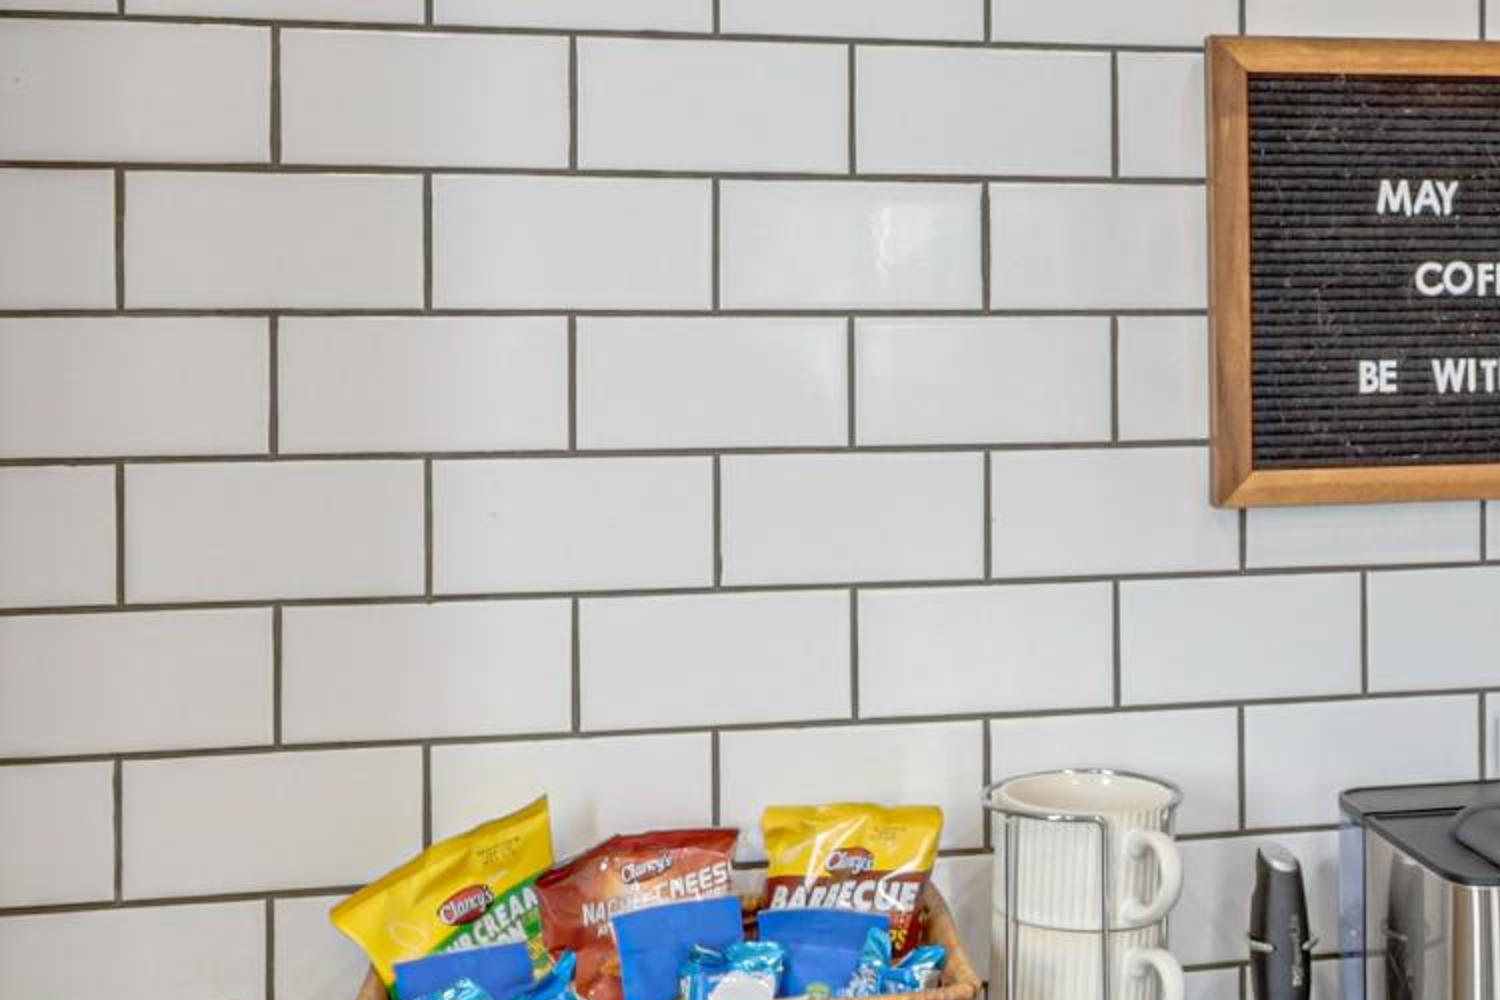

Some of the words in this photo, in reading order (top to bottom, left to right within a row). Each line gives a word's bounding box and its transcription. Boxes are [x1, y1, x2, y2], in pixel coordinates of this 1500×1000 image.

[1376, 179, 1459, 217] MAY
[1359, 359, 1398, 393] BE
[440, 885, 493, 923] Clancy's
